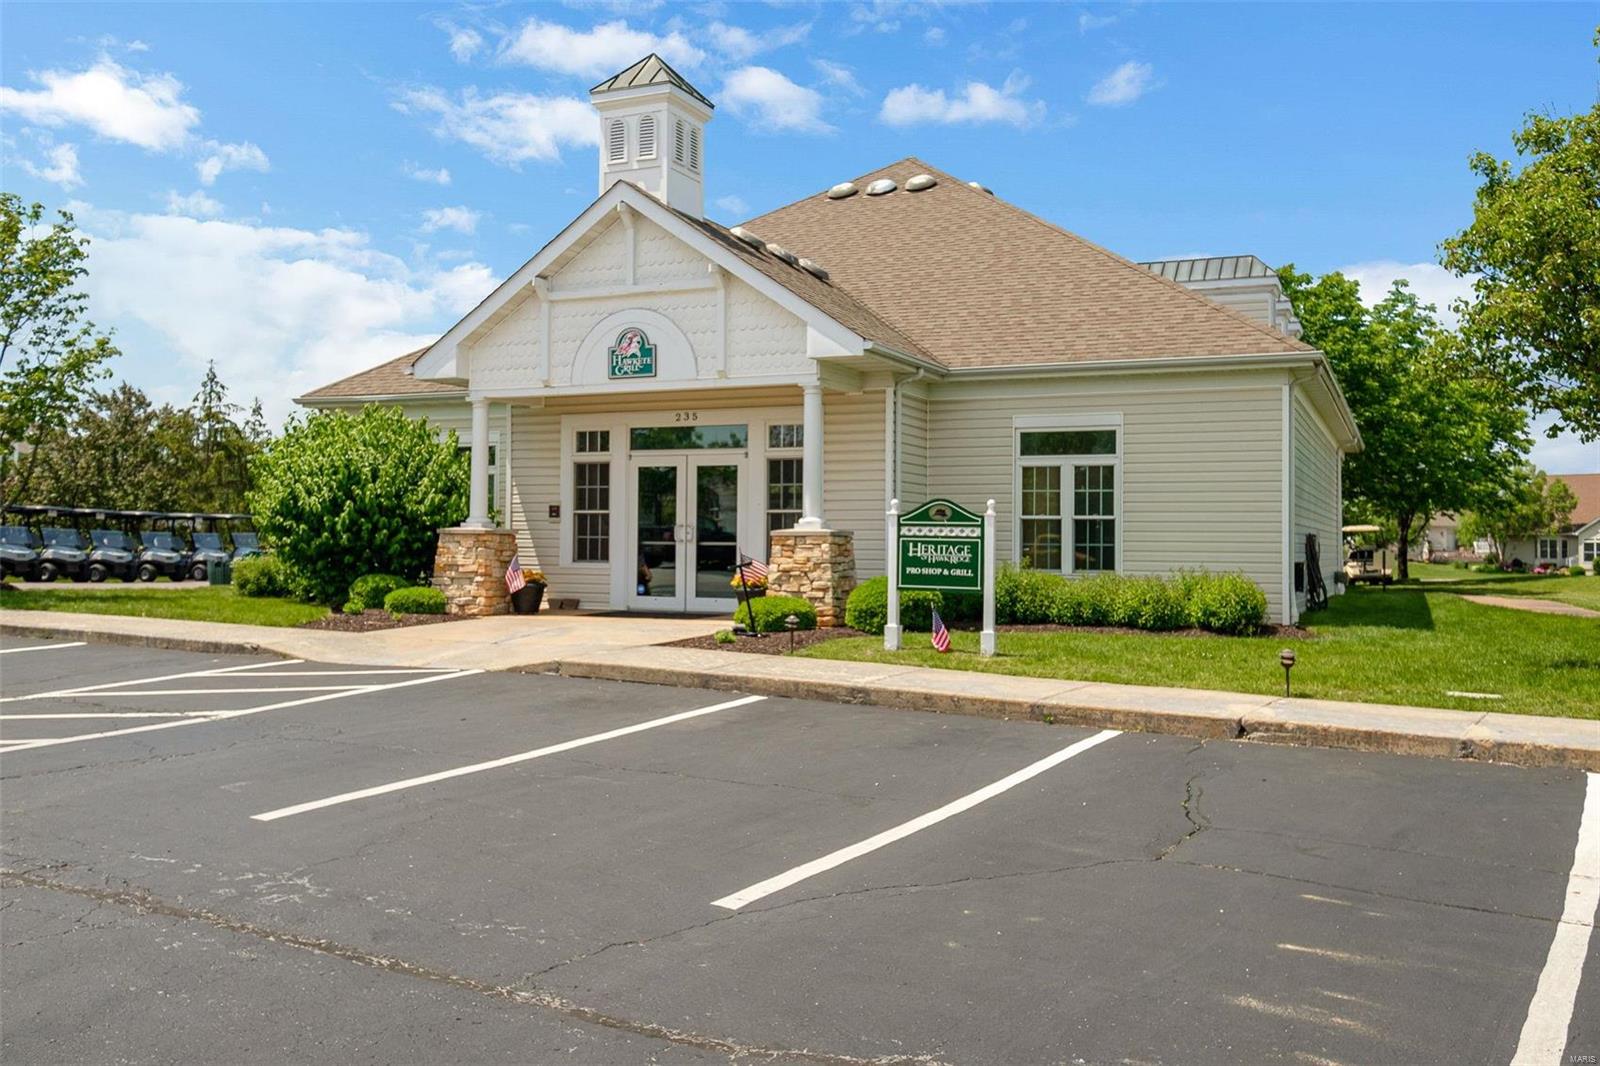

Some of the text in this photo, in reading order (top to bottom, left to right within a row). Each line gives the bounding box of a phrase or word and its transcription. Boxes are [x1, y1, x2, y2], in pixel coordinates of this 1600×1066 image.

[675, 412, 698, 421] 235
[907, 542, 972, 557] HERITAGE
[950, 569, 974, 577] GRILL
